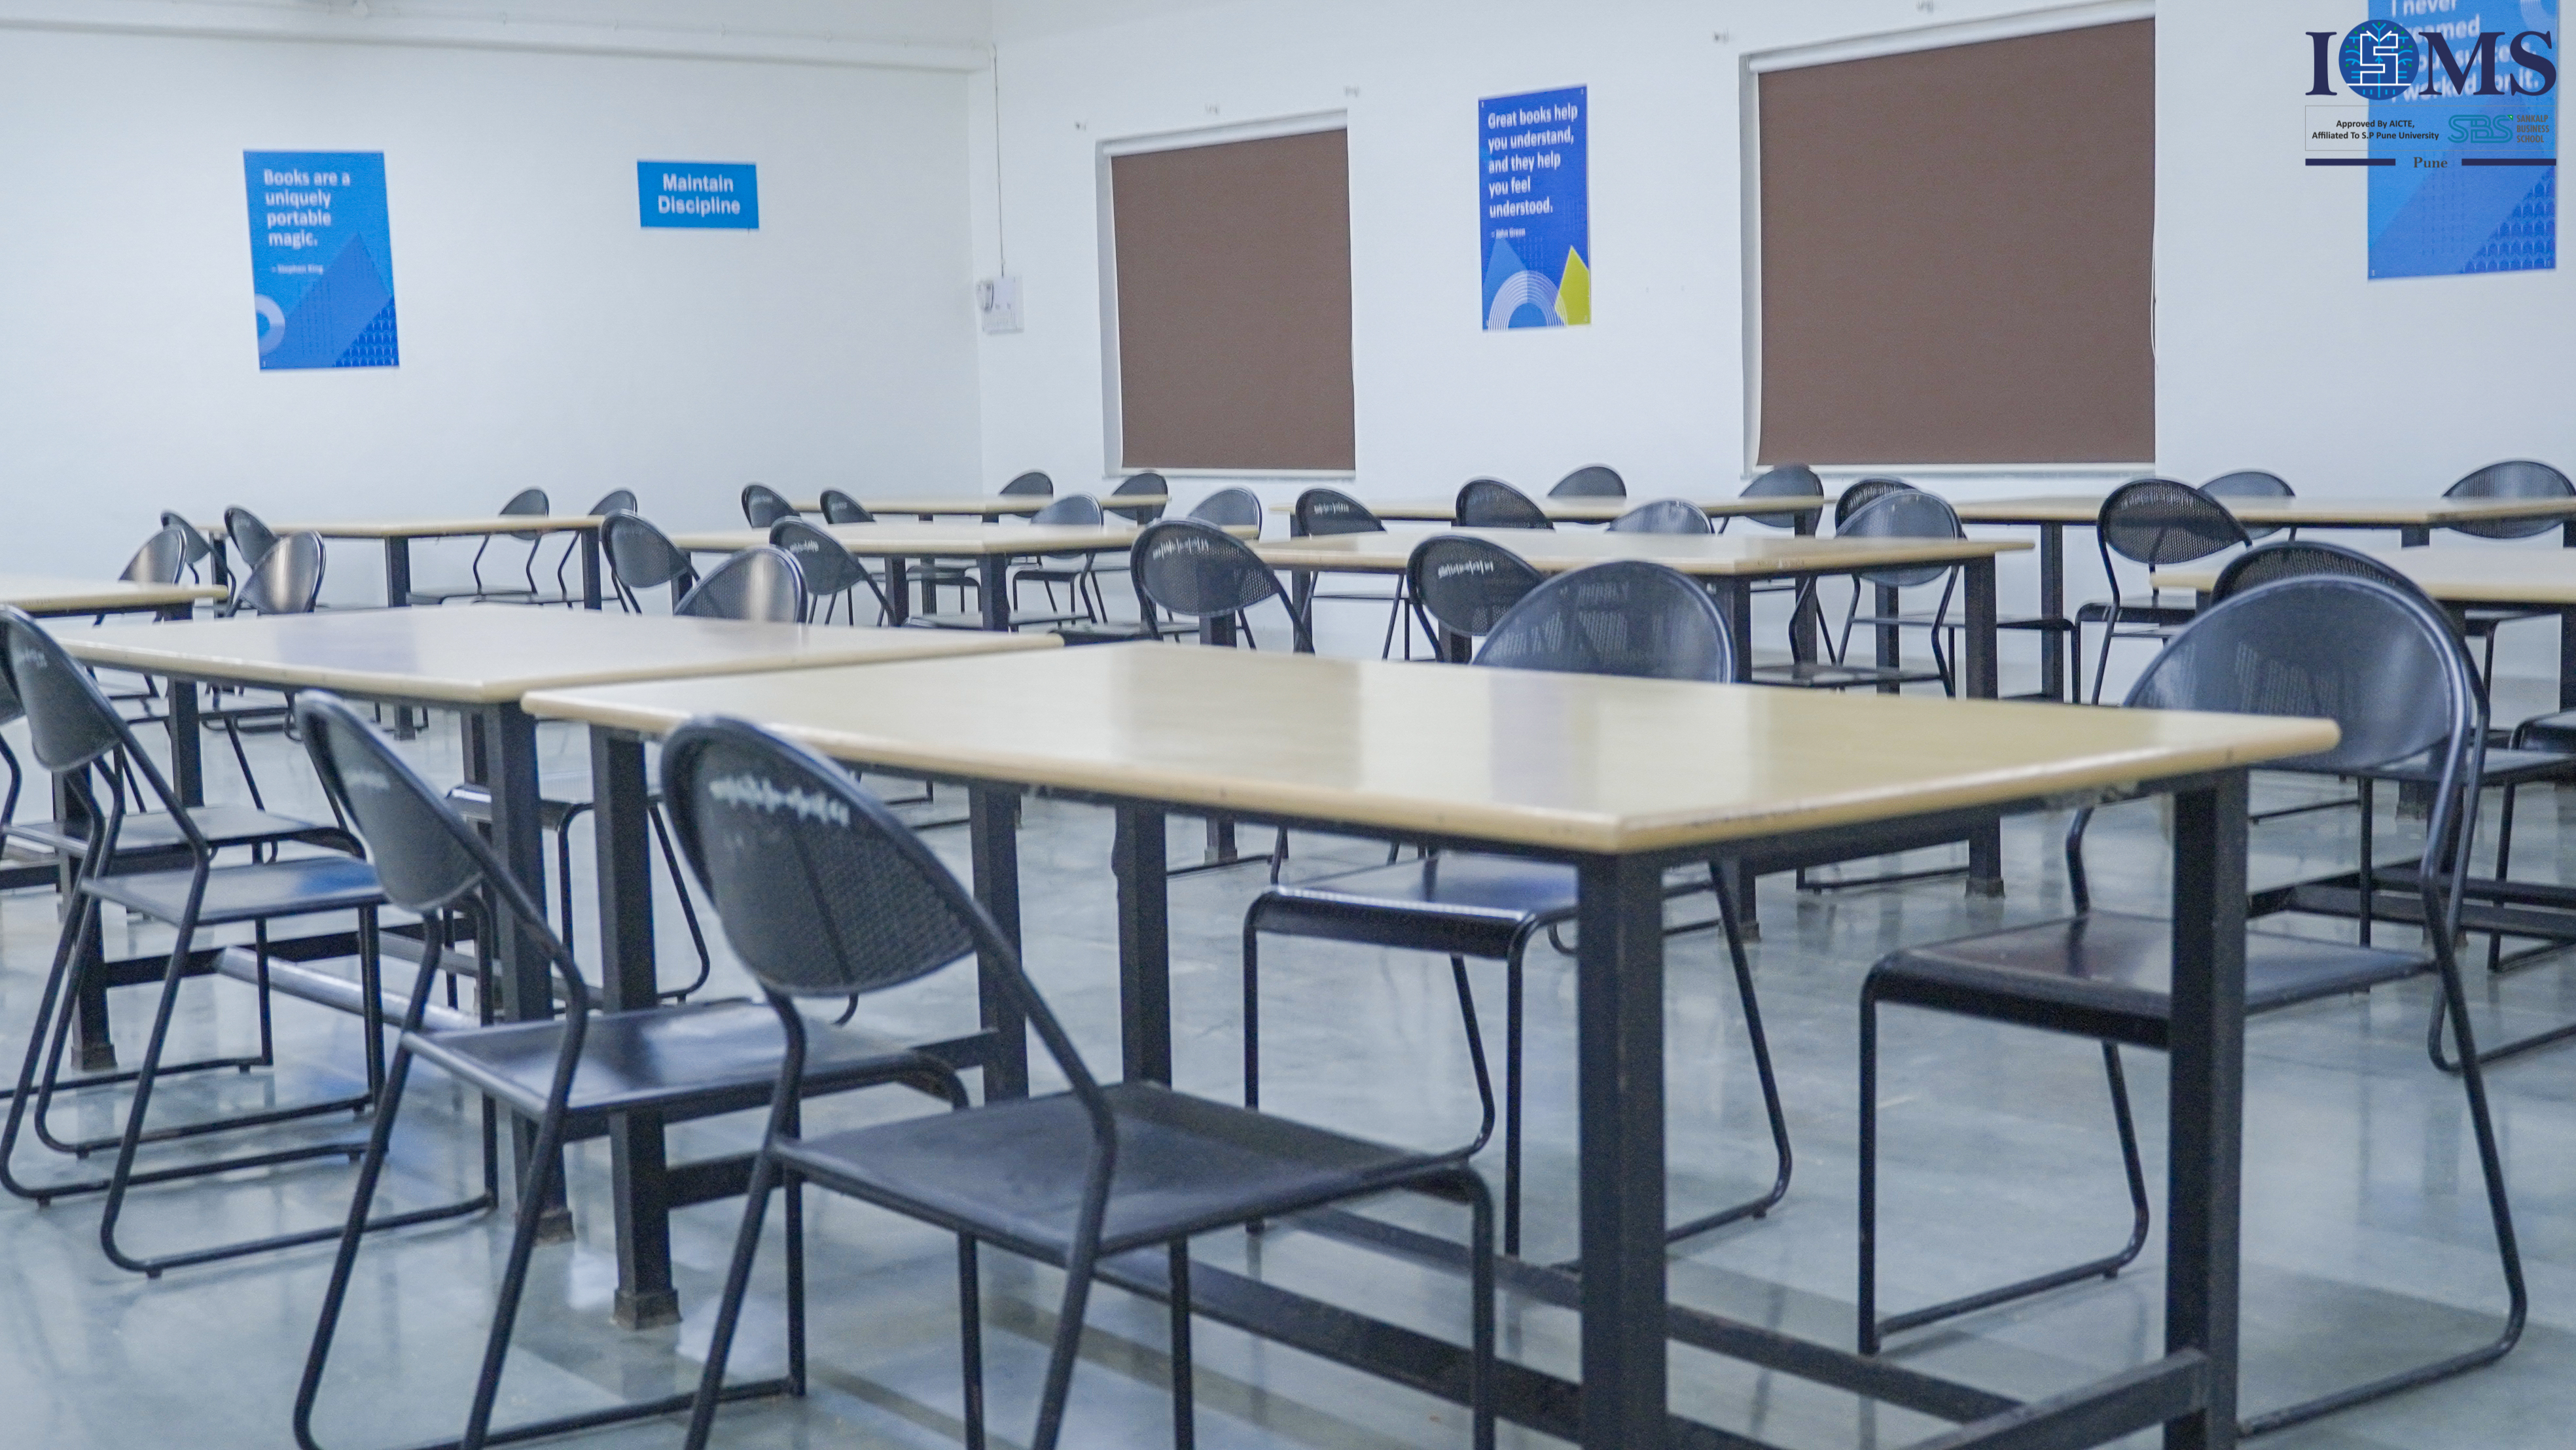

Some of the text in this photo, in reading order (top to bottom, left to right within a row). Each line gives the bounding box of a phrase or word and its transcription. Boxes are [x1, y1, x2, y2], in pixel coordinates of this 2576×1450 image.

[1488, 102, 1578, 130] Great books help
[1488, 125, 1575, 155] you understand,
[1489, 150, 1561, 174] and they help
[264, 169, 351, 186] Books are a
[663, 173, 734, 192] Maintain
[1489, 175, 1531, 199] you feel
[266, 189, 331, 209] uniquely
[658, 195, 741, 218] Discipline
[1490, 196, 1554, 219] understood.
[268, 209, 332, 229] portable
[268, 229, 318, 250] magic.
